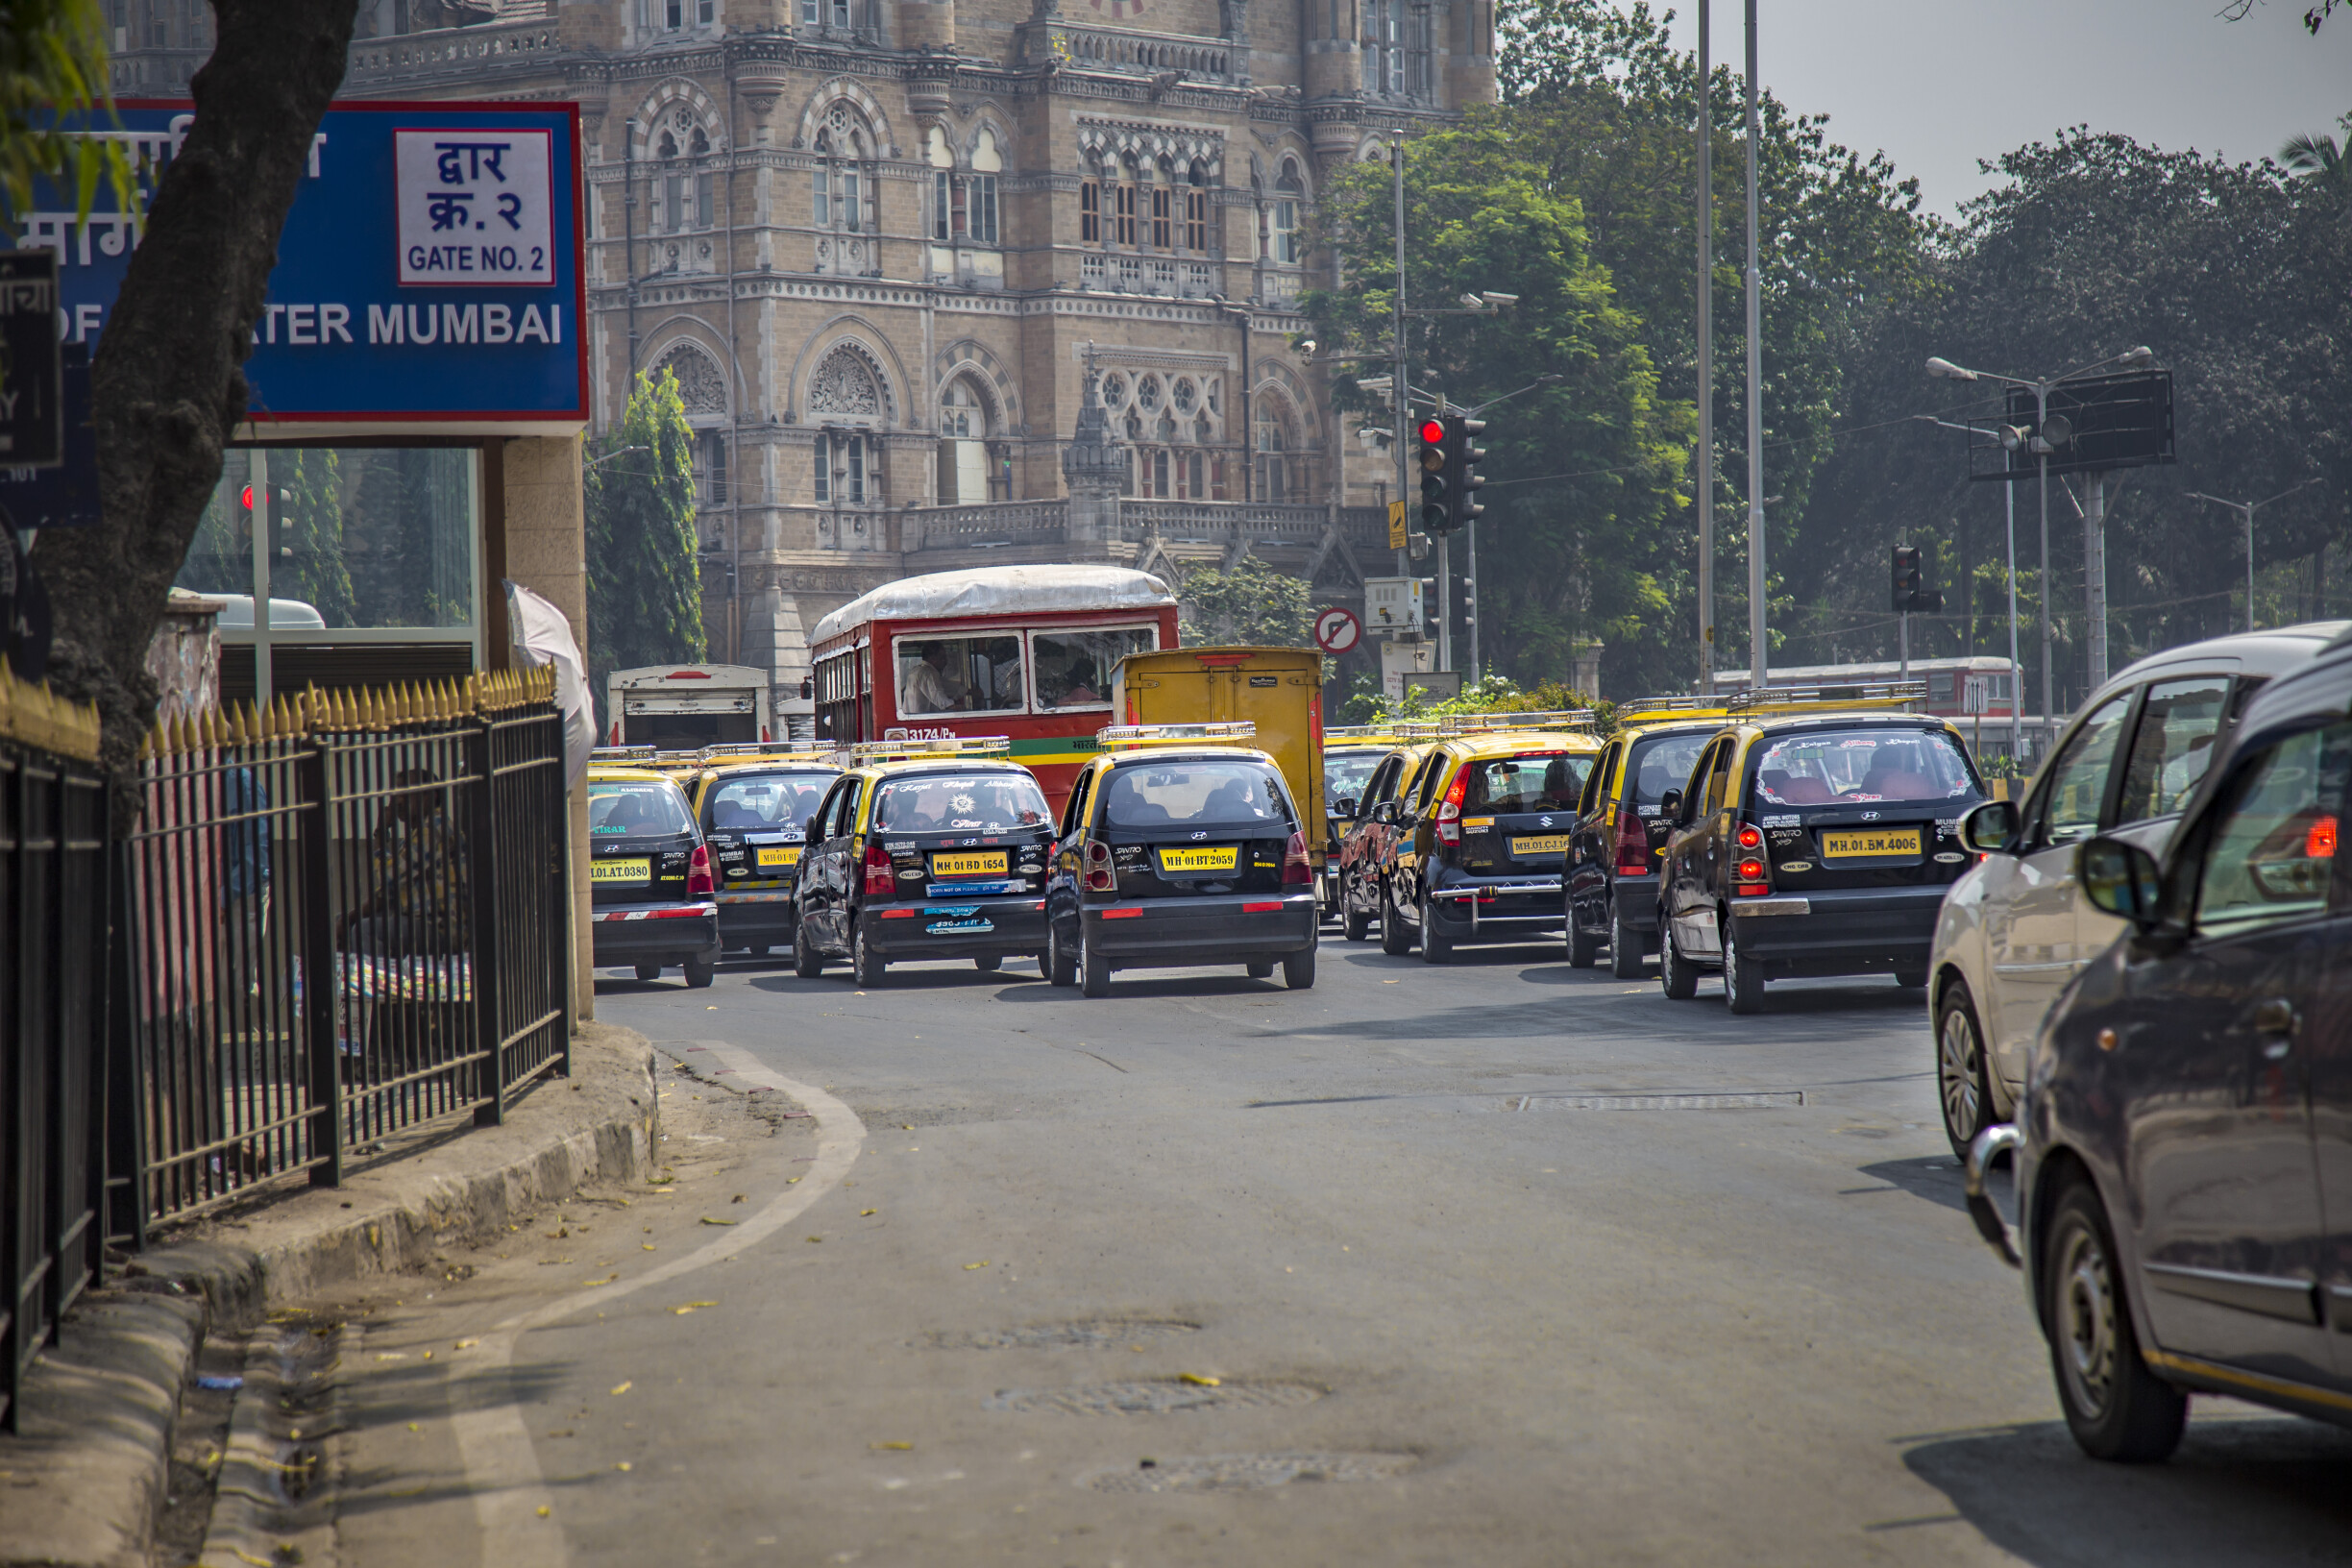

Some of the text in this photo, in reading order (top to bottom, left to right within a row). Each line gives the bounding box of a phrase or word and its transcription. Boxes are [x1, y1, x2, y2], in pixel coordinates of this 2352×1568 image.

[434, 142, 511, 184] द्वार
[497, 192, 522, 232] २
[408, 245, 544, 271] GATE NO. 2
[368, 304, 560, 344] MUMBAI
[593, 825, 626, 834] VIRAR
[1770, 829, 1802, 839] SANTRO
[1115, 846, 1142, 855] SANTRO
[1829, 838, 1917, 852] MH.01.BM.4006
[983, 859, 1004, 869] 1654
